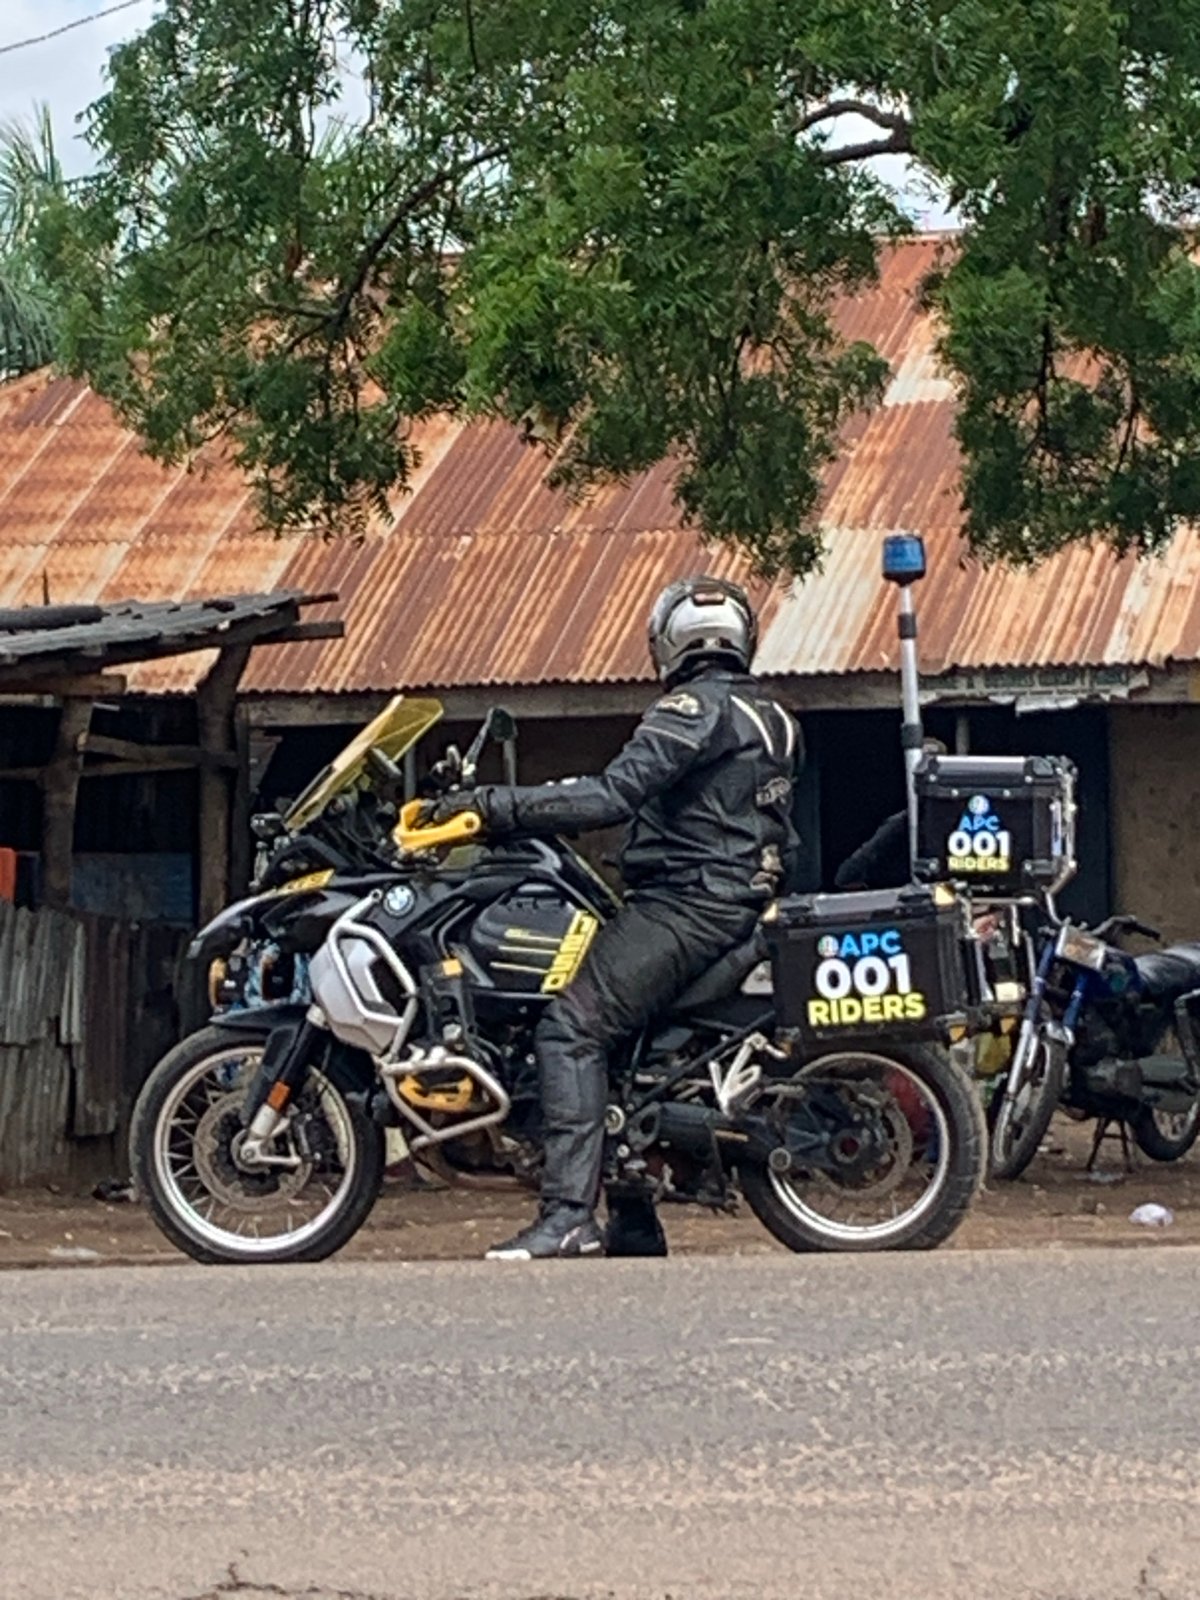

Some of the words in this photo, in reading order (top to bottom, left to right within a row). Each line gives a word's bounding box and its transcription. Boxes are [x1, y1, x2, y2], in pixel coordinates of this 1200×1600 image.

[959, 815, 1000, 831] APC
[947, 831, 1010, 857] 001
[948, 857, 1008, 871] RIDERS
[840, 930, 902, 957] APC
[816, 954, 911, 999] 001
[808, 993, 925, 1026] RIDERS
